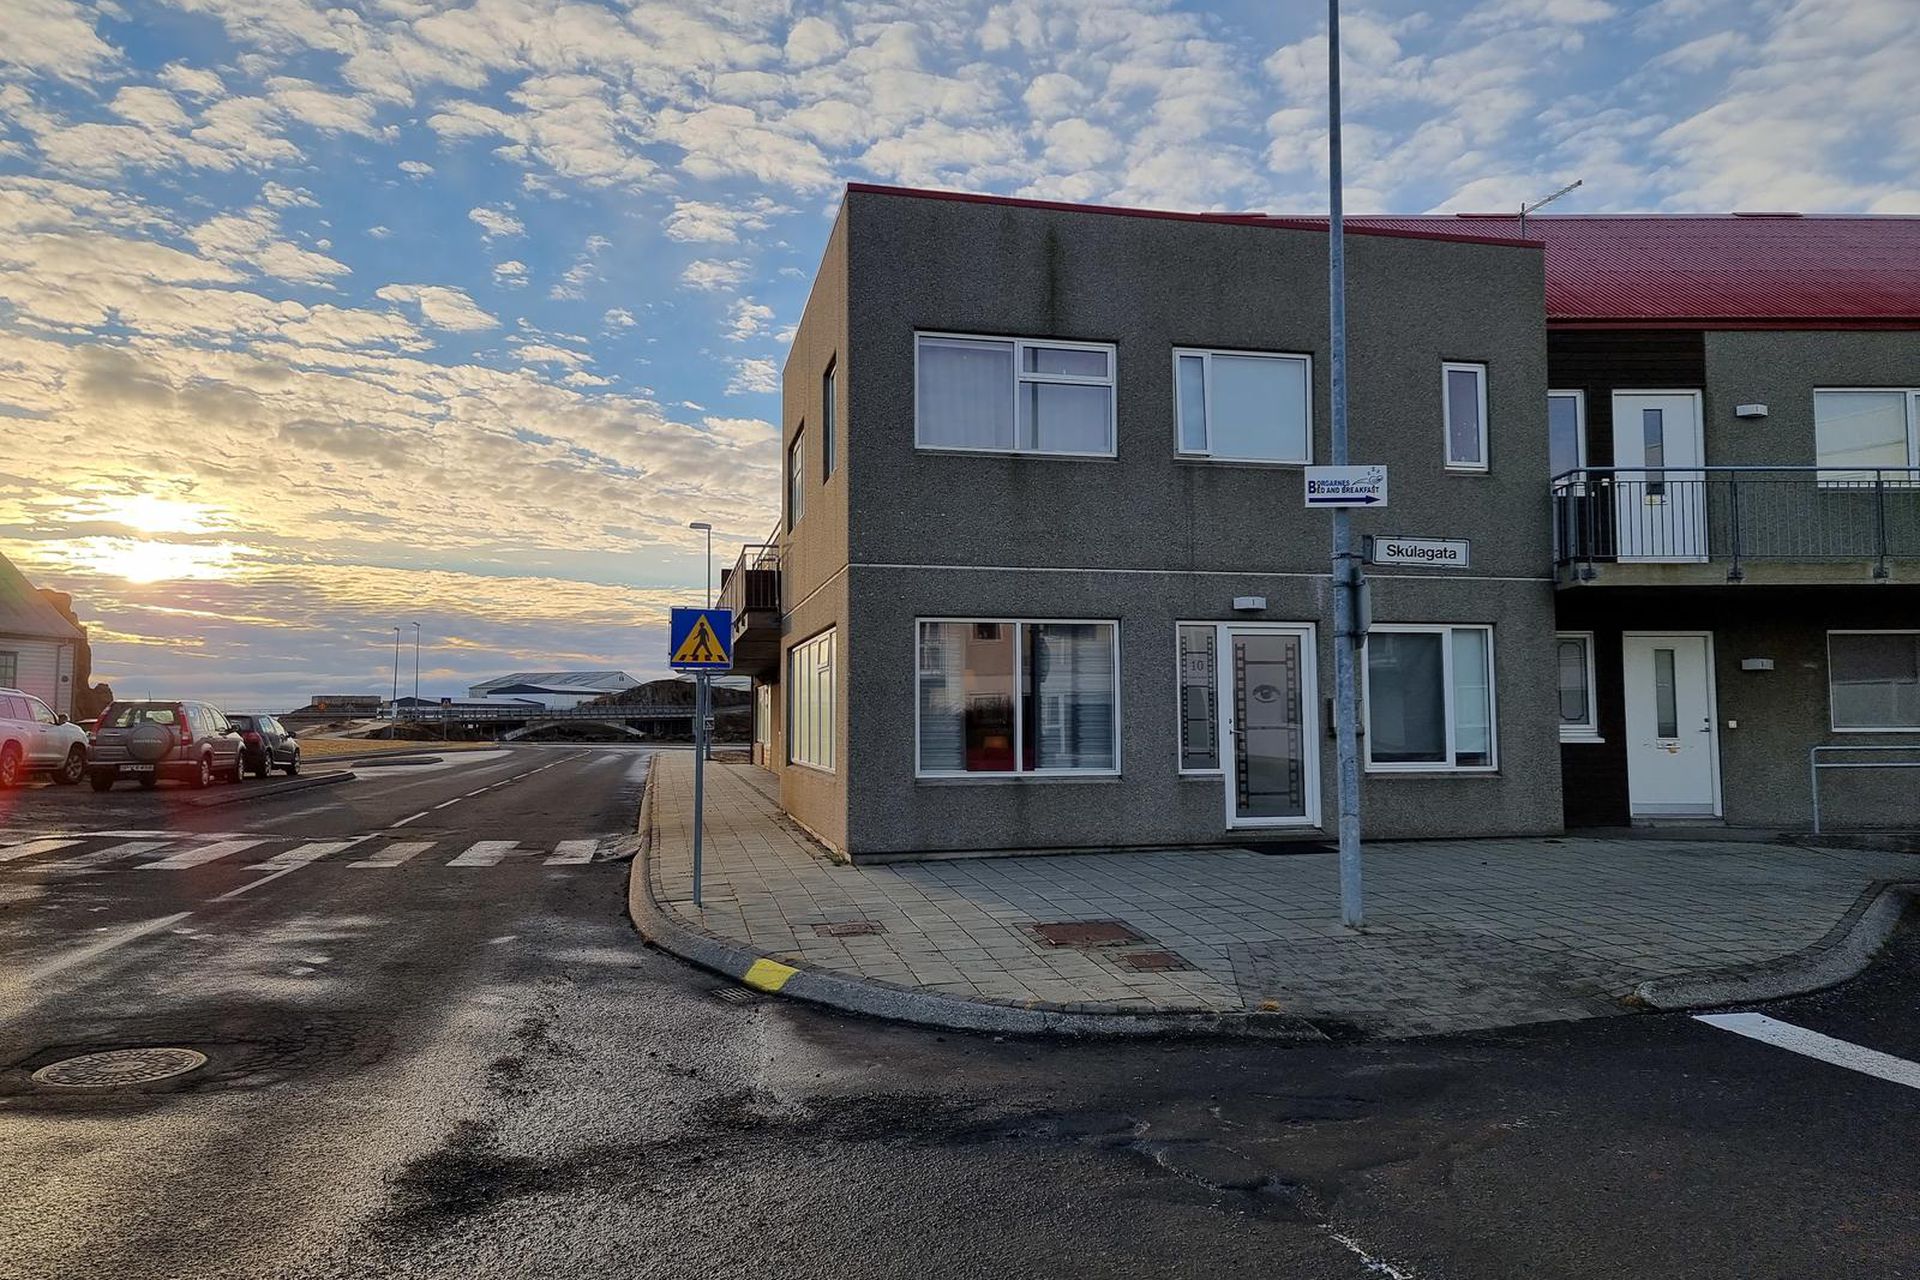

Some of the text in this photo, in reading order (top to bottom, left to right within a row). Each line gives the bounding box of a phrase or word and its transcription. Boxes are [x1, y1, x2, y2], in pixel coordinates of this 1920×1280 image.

[1326, 486, 1340, 494] AND
[1341, 486, 1380, 494] BREAKFAST
[1386, 544, 1457, 560] Skúlagata
[1191, 660, 1204, 671] 10
